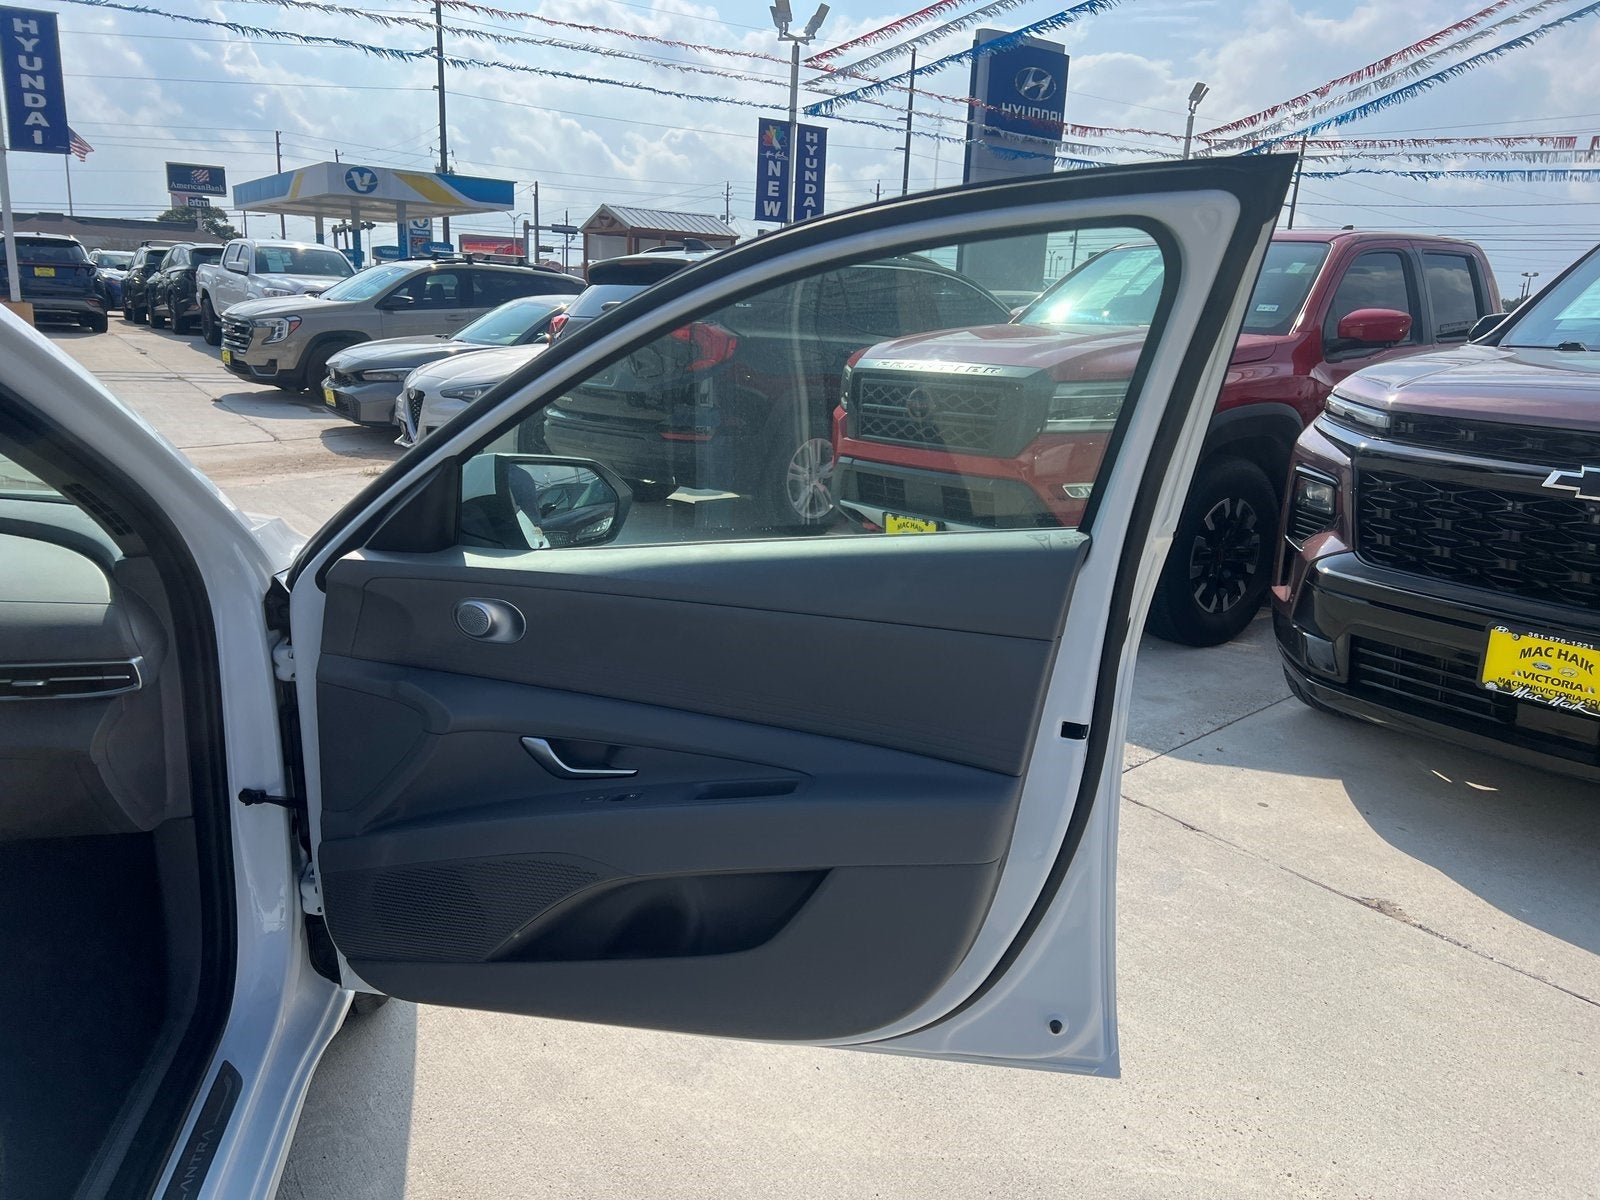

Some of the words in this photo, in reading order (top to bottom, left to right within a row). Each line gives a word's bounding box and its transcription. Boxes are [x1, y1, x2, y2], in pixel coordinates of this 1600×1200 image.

[13, 18, 50, 145] HYUNDAI
[1001, 102, 1062, 123] HYUNDAI
[171, 181, 224, 192] AmericanBank
[763, 160, 781, 217] NEW
[803, 131, 818, 219] HYUNDAI
[189, 198, 209, 207] atm
[1519, 646, 1554, 660] MAC
[1557, 648, 1595, 676] HAIK
[1497, 677, 1600, 706] MACHAIKVICTORIACO
[1523, 670, 1584, 693] VICTORIA
[180, 1128, 214, 1200] ANTRA
